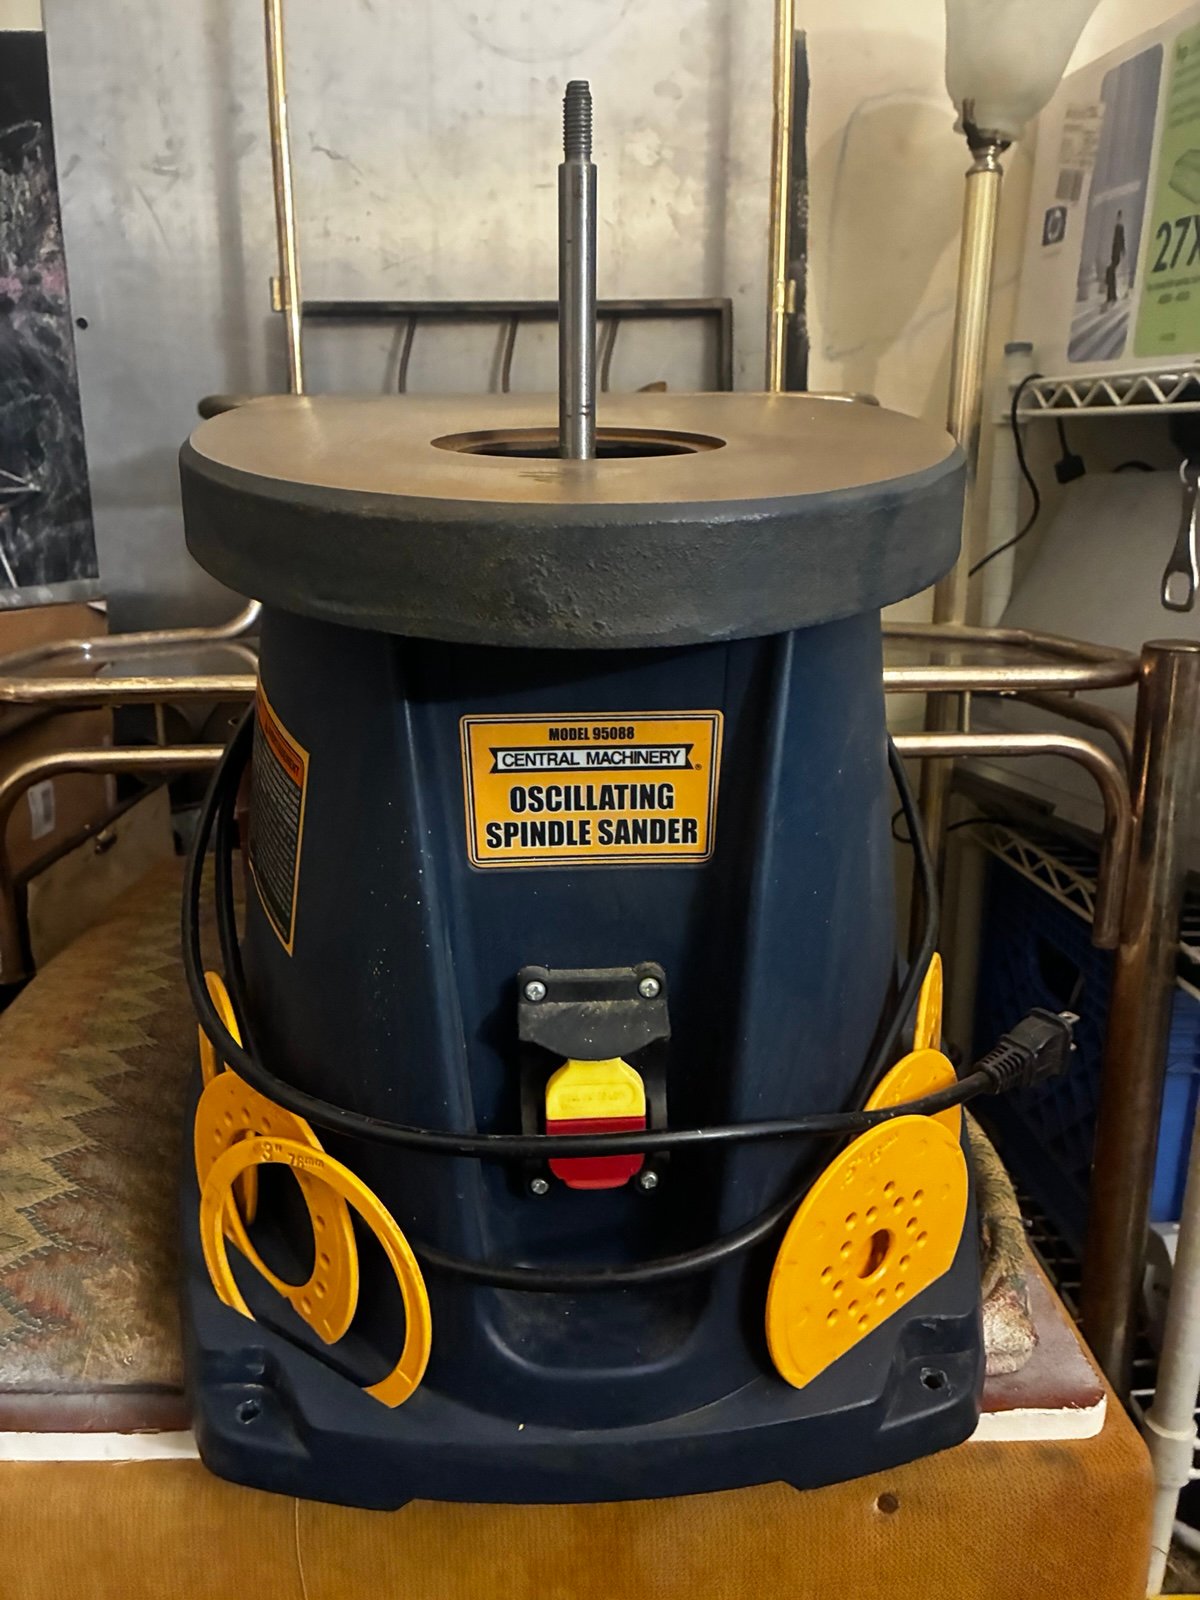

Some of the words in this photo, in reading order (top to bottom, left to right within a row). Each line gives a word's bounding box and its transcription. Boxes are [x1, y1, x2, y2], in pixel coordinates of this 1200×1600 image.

[549, 727, 590, 741] MODEL
[592, 726, 635, 741] 95088
[502, 752, 580, 768] CENTRAL
[586, 750, 682, 765] MACHINERY
[509, 783, 675, 813] OSCILLATING
[486, 820, 591, 848] SPINDLE
[598, 818, 698, 845] SANDER
